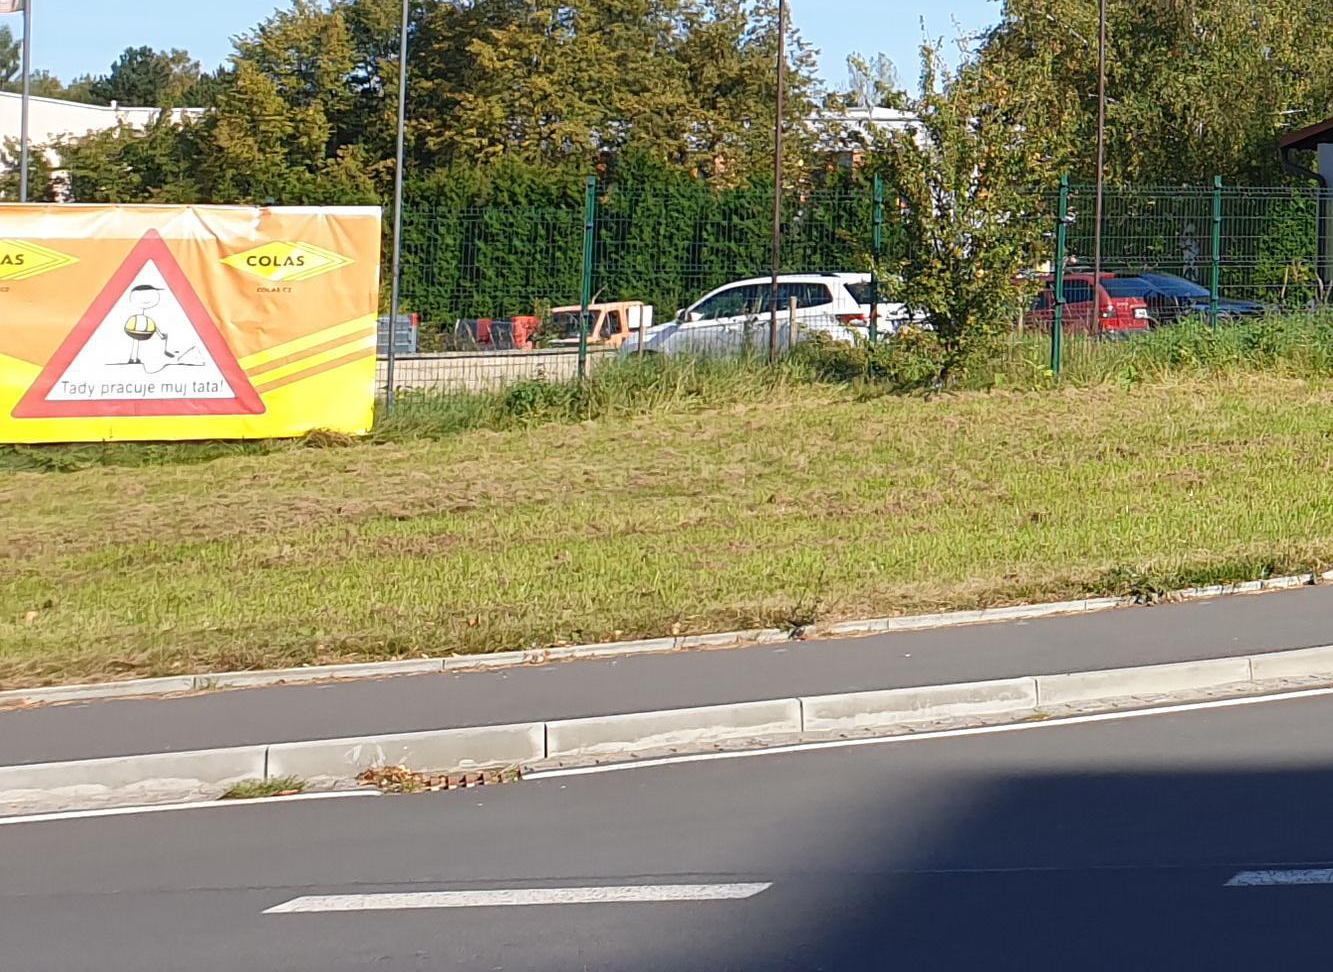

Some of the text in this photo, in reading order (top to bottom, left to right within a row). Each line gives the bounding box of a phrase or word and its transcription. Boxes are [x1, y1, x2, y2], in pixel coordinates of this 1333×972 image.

[246, 255, 305, 267] COLAS
[61, 381, 95, 398] Tady
[101, 381, 156, 397] pracuje
